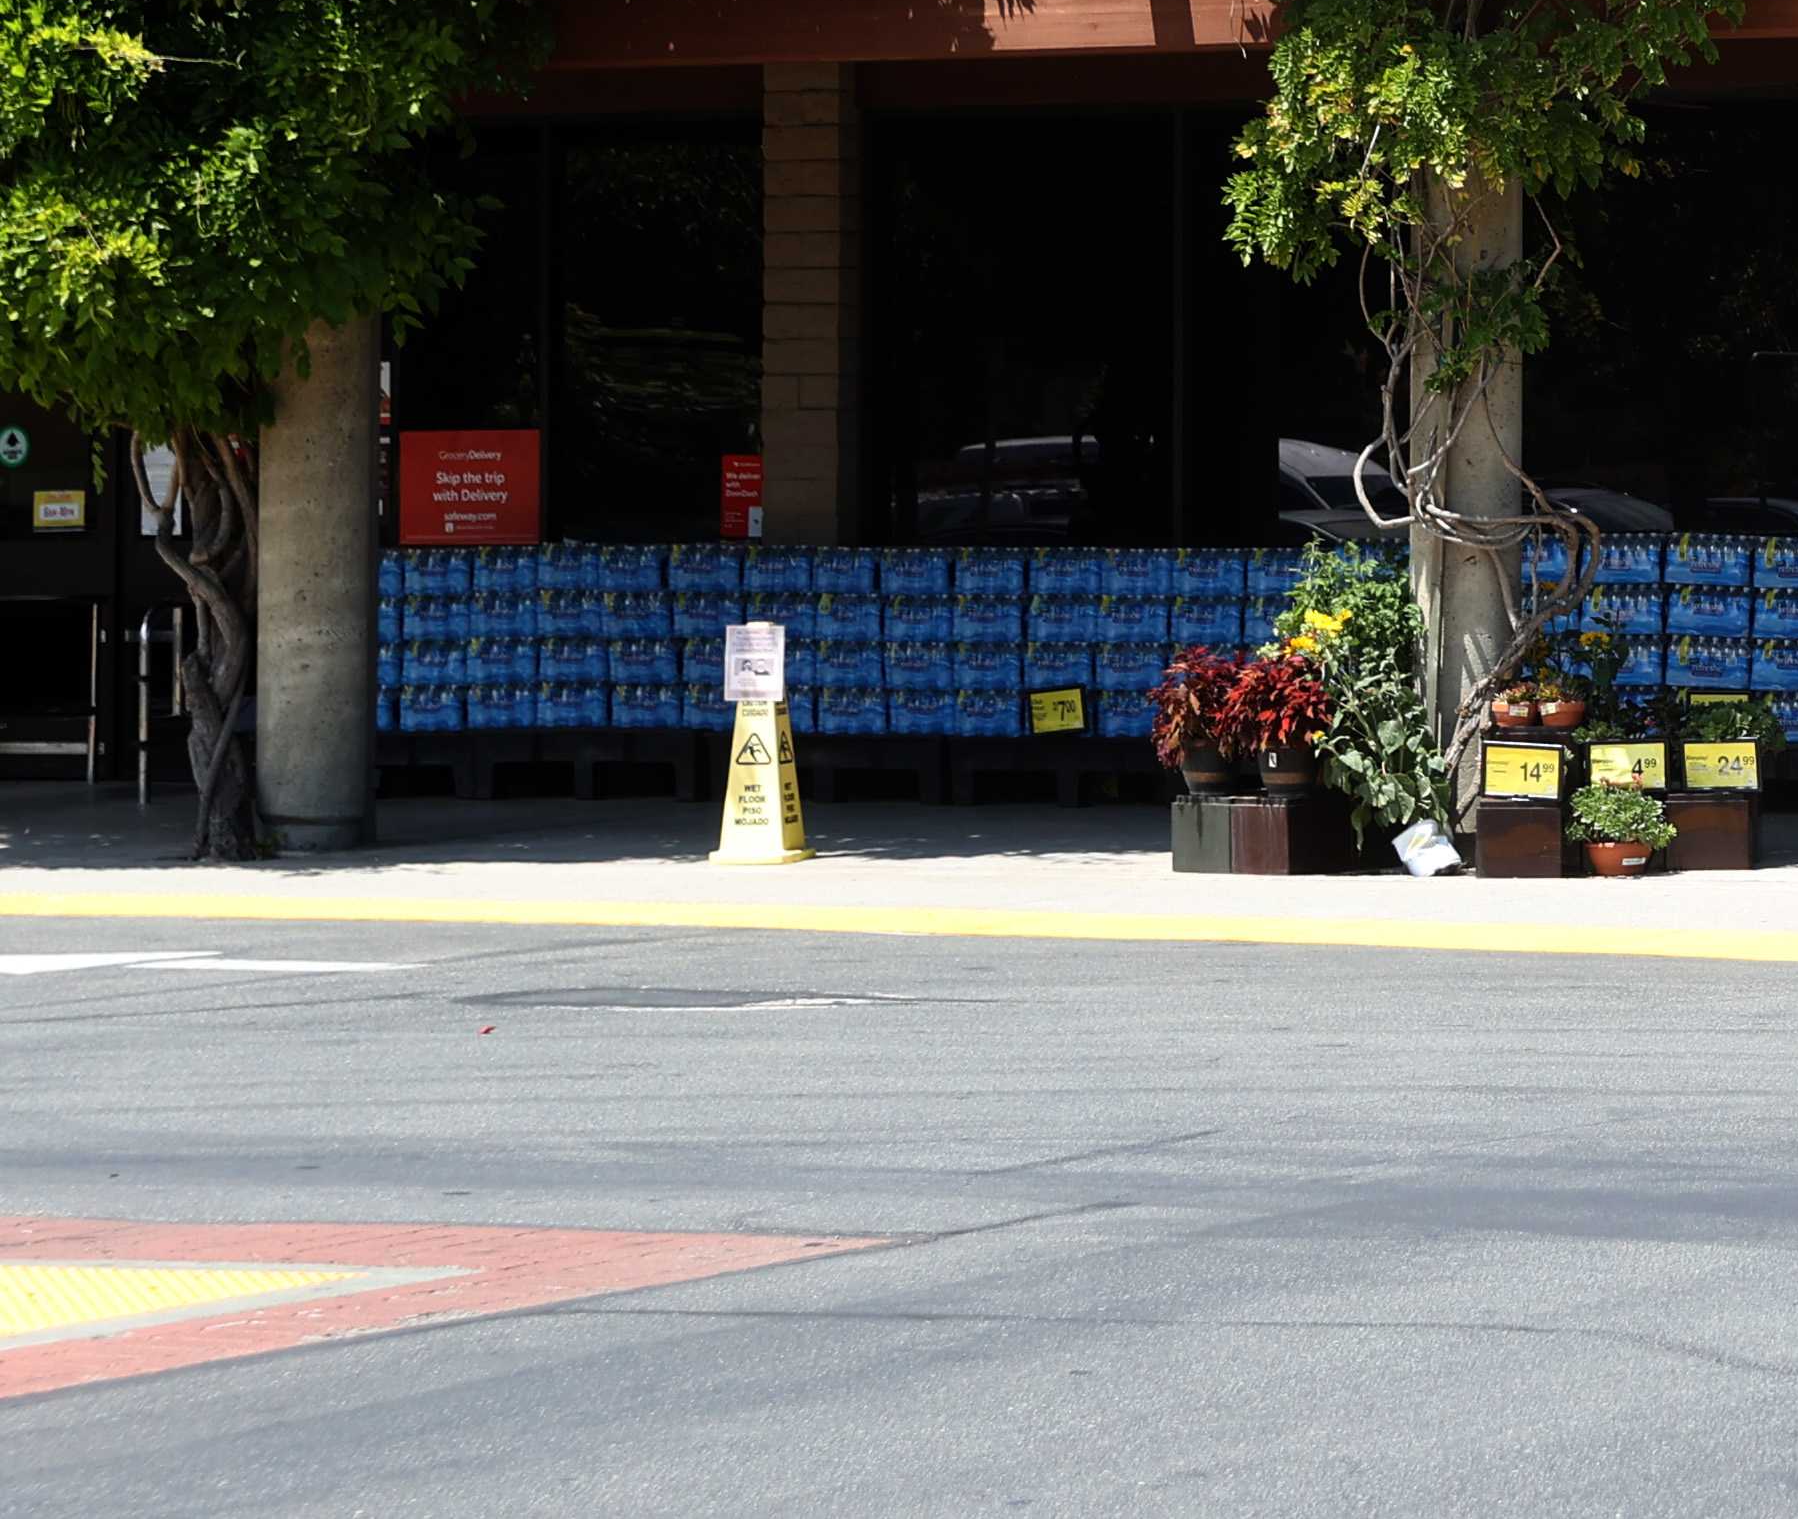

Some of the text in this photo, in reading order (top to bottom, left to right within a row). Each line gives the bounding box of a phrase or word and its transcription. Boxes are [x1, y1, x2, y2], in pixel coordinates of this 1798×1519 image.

[436, 472, 506, 486] Skip the trip
[433, 489, 508, 503] with Delivery
